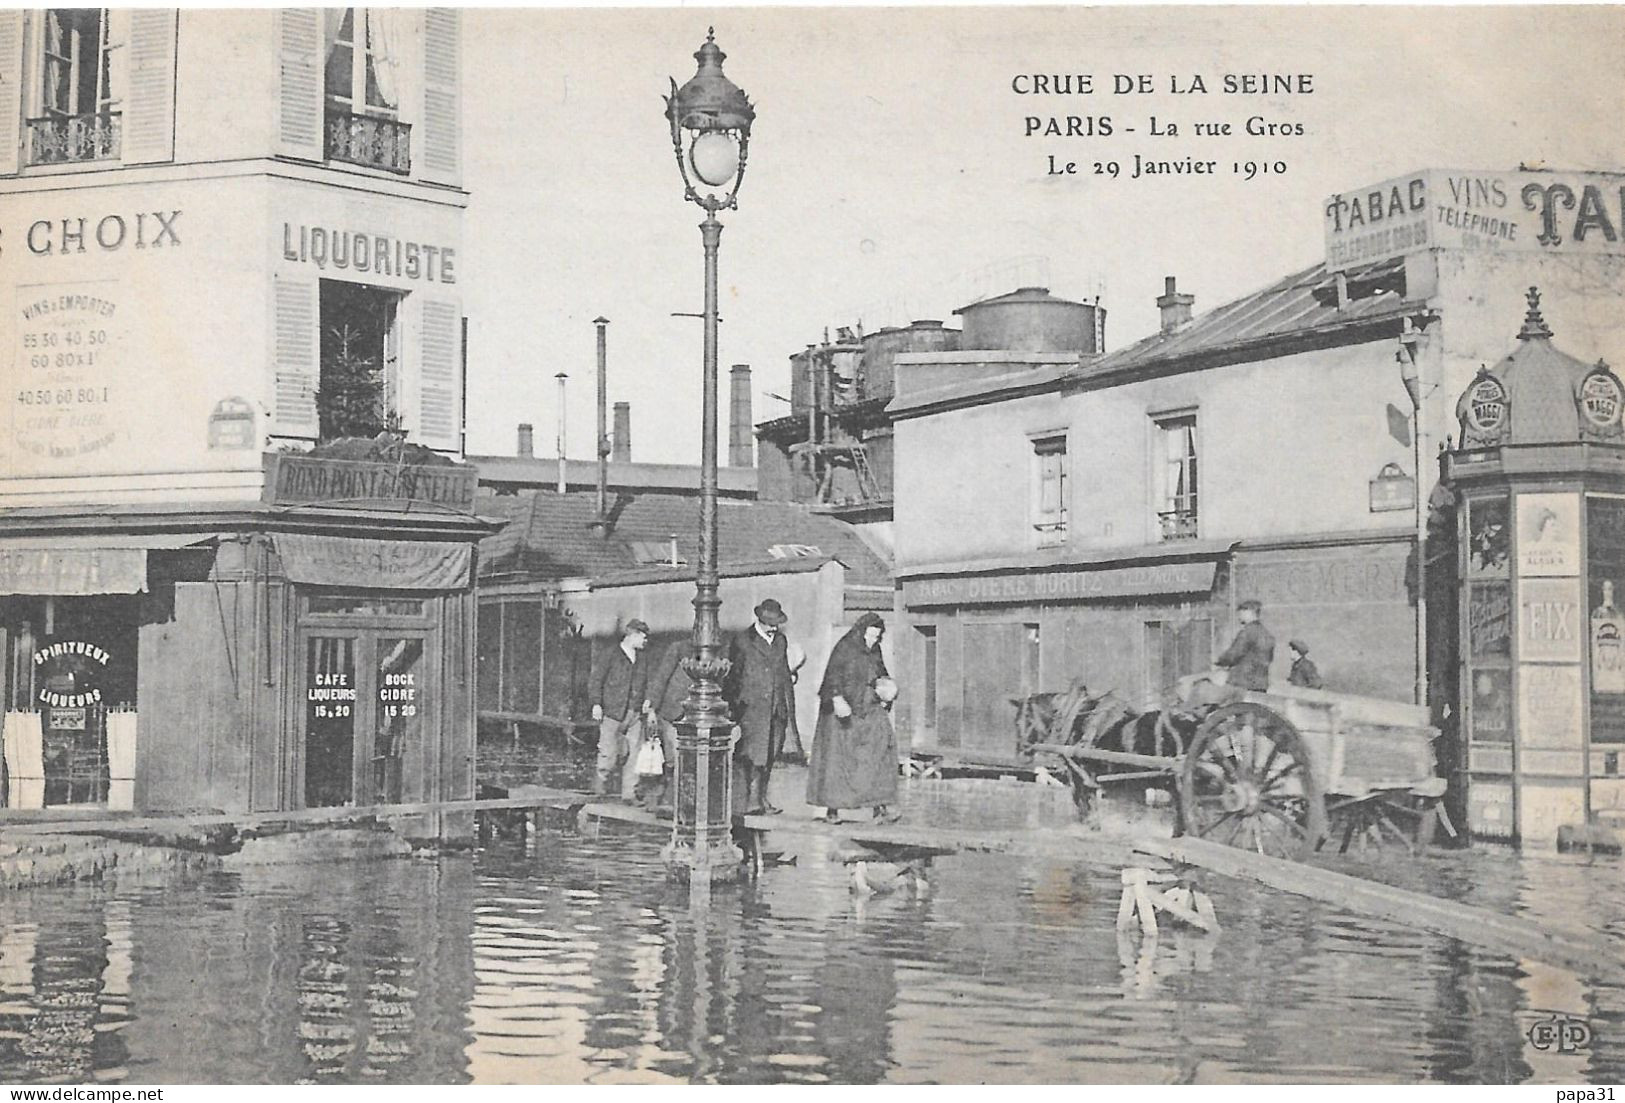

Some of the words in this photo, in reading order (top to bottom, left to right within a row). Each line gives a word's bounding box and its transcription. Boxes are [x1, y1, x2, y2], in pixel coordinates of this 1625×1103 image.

[1449, 177, 1507, 208] VINS
[1327, 178, 1426, 233] TABAC
[1521, 183, 1625, 247] TA
[27, 210, 183, 257] CHOIX
[283, 222, 457, 284] LIQUORISTE
[22, 299, 49, 320] VINS
[59, 295, 116, 318] EMPORTER
[89, 329, 107, 345] 50
[31, 354, 49, 368] 60
[55, 352, 75, 368] 80
[18, 390, 33, 405] 40
[36, 390, 52, 405] 50
[56, 388, 72, 404] 60
[1034, 572, 1102, 595] MORITZ
[1529, 601, 1573, 640] FIX
[34, 641, 110, 665] SPIRITUEUX
[315, 674, 347, 686] CAFE
[385, 674, 414, 686] BOCK
[39, 688, 102, 707] LIQUEURS
[308, 689, 356, 701] LIQUEURS
[381, 689, 415, 701] CIDRE
[315, 705, 326, 717] 15
[335, 705, 350, 717] 20
[385, 705, 397, 717] 15
[401, 704, 416, 717] 20
